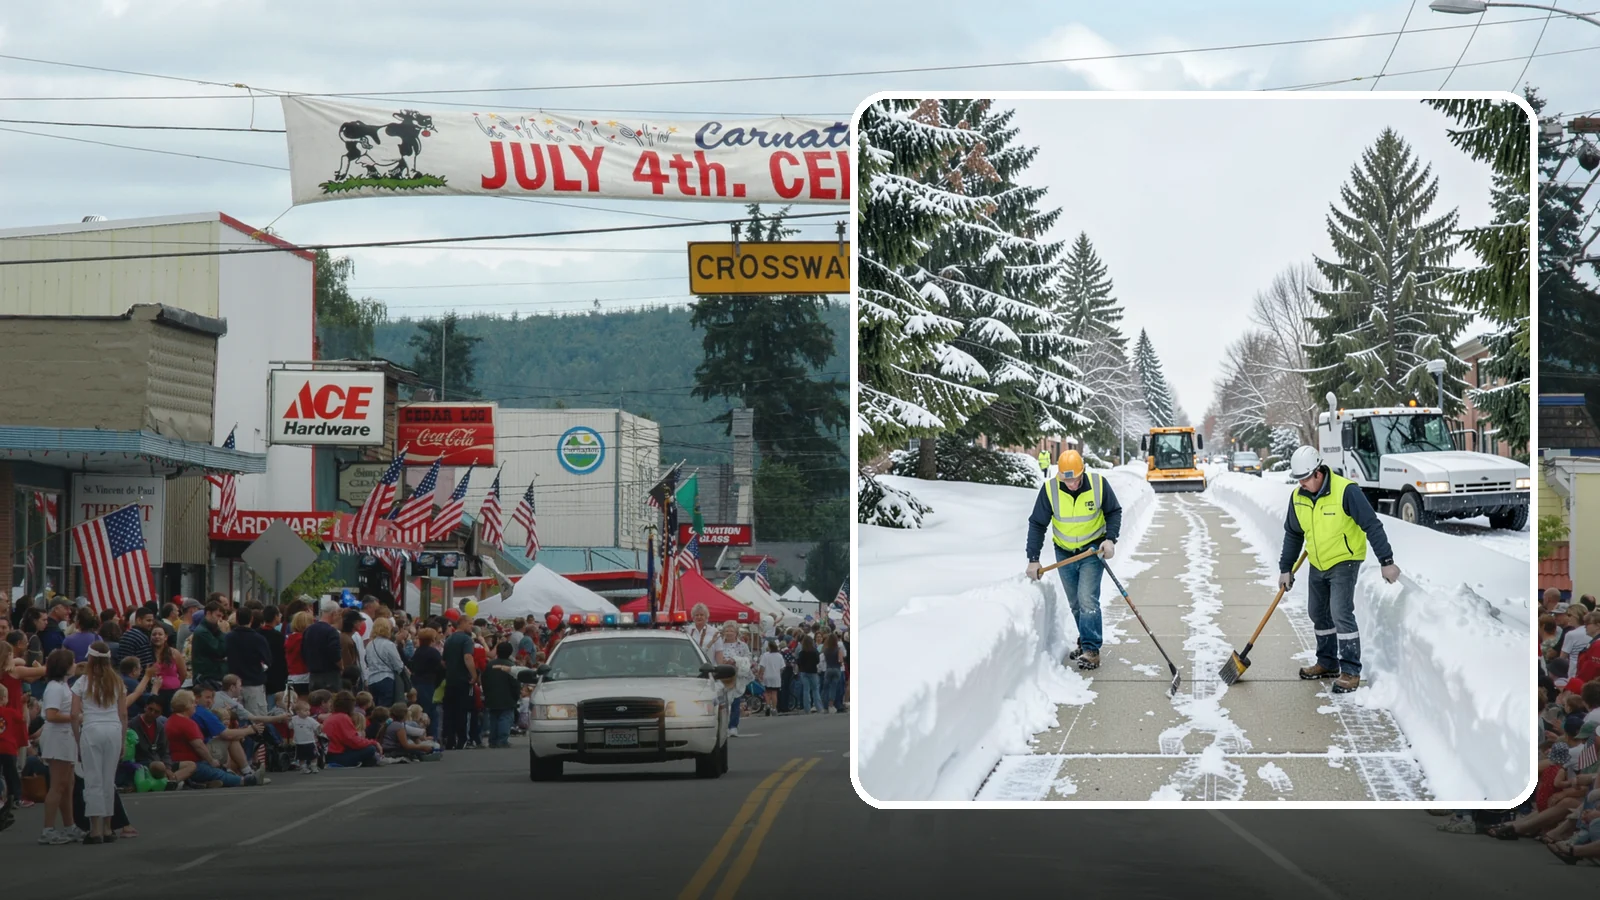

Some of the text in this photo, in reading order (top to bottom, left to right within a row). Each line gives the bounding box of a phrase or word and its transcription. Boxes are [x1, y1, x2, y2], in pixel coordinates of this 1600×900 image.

[481, 141, 605, 192] JULY
[632, 150, 747, 198] 4th.
[696, 254, 850, 280] CROSSWA
[282, 380, 374, 420] ACE
[405, 409, 485, 422] CEDAR LOG
[283, 421, 371, 436] Hardware
[416, 428, 477, 447] Coca-Cola
[353, 467, 384, 480] Simpl
[83, 484, 155, 495] St. Vincent de Paul
[212, 516, 331, 535] HARDARE
[688, 526, 741, 536] CRNATION
[698, 535, 730, 543] GLASS
